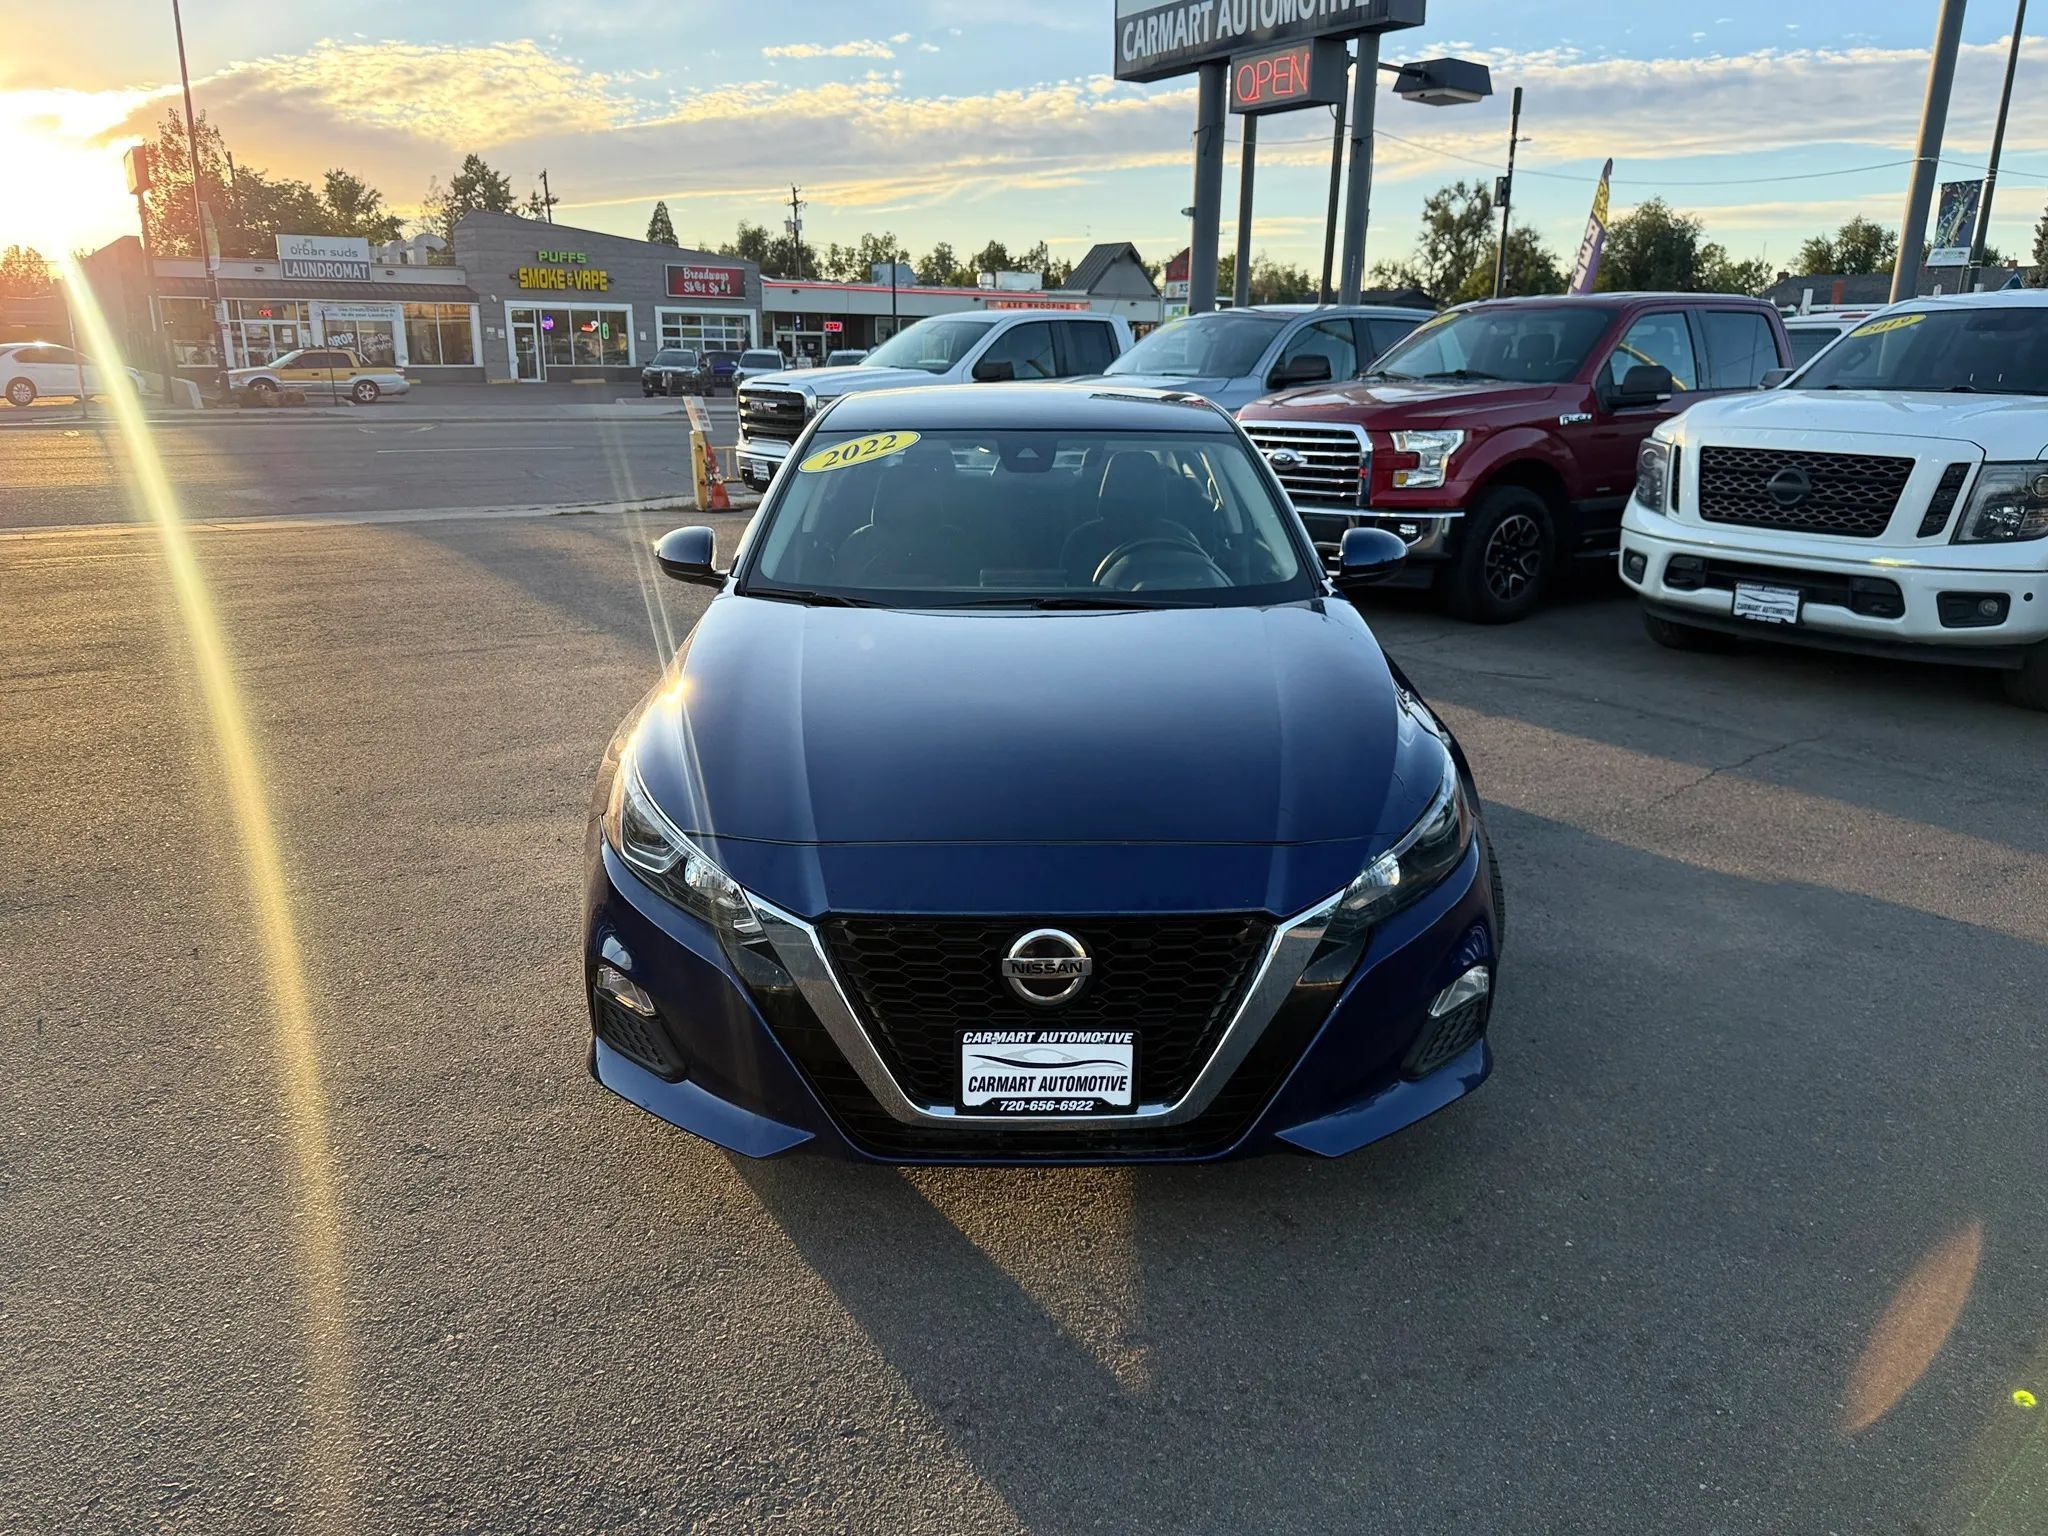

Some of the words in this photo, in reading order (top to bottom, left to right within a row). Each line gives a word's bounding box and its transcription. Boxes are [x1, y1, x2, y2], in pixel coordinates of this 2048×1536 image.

[1122, 1, 1214, 62] CARMART
[1216, 0, 1370, 40] AUTOMO
[1236, 53, 1311, 102] OPEN
[330, 246, 359, 259] suds
[538, 250, 588, 264] PUFFS
[284, 261, 368, 279] LAUNDROMAT
[518, 267, 566, 290] SMOKE
[573, 270, 608, 292] VAPE
[822, 434, 898, 468] 2022
[1011, 962, 1083, 975] NISSAN
[962, 1032, 1036, 1044] CARMART
[1037, 1032, 1134, 1044] AUTOMOTIVE
[968, 1075, 1037, 1093] CARMART
[1038, 1075, 1129, 1093] AUTOMOTIVE
[999, 1100, 1095, 1112] 720-656-6922
